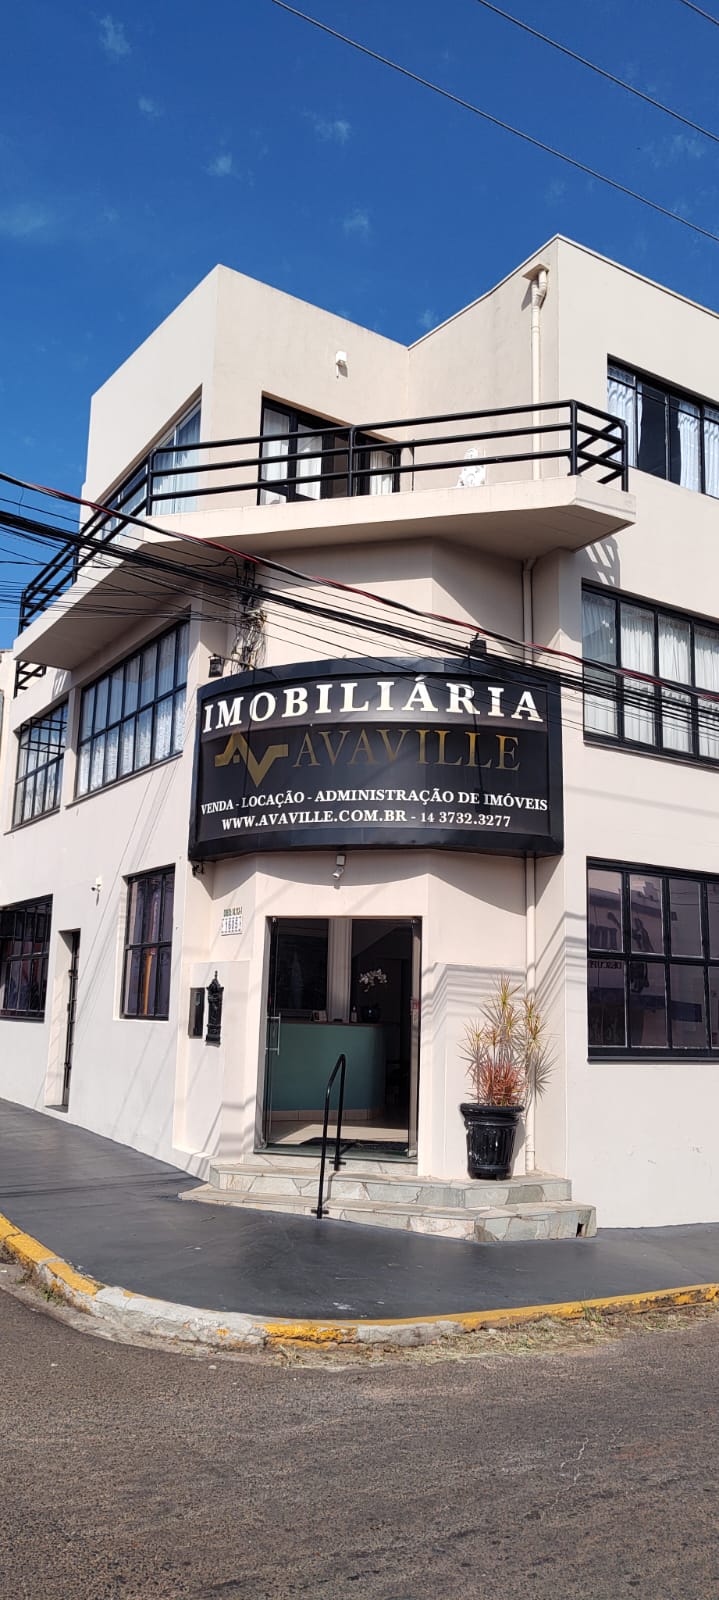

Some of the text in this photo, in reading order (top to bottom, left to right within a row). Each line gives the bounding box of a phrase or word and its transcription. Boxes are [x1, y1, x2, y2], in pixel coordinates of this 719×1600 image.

[203, 674, 544, 733] IMOBILIÁRIA
[292, 728, 521, 771] AVAVILLE
[201, 799, 234, 815] VENDA
[241, 790, 305, 809] LOCAÇÃO
[315, 788, 455, 805] ADMINISTRAÇÃO
[458, 792, 480, 804] DE
[484, 793, 548, 811] IMÓVEIS
[222, 809, 407, 831] WWW.AVAVILLE.COM.BR
[421, 812, 435, 822] 14
[439, 811, 511, 828] 3732.3277
